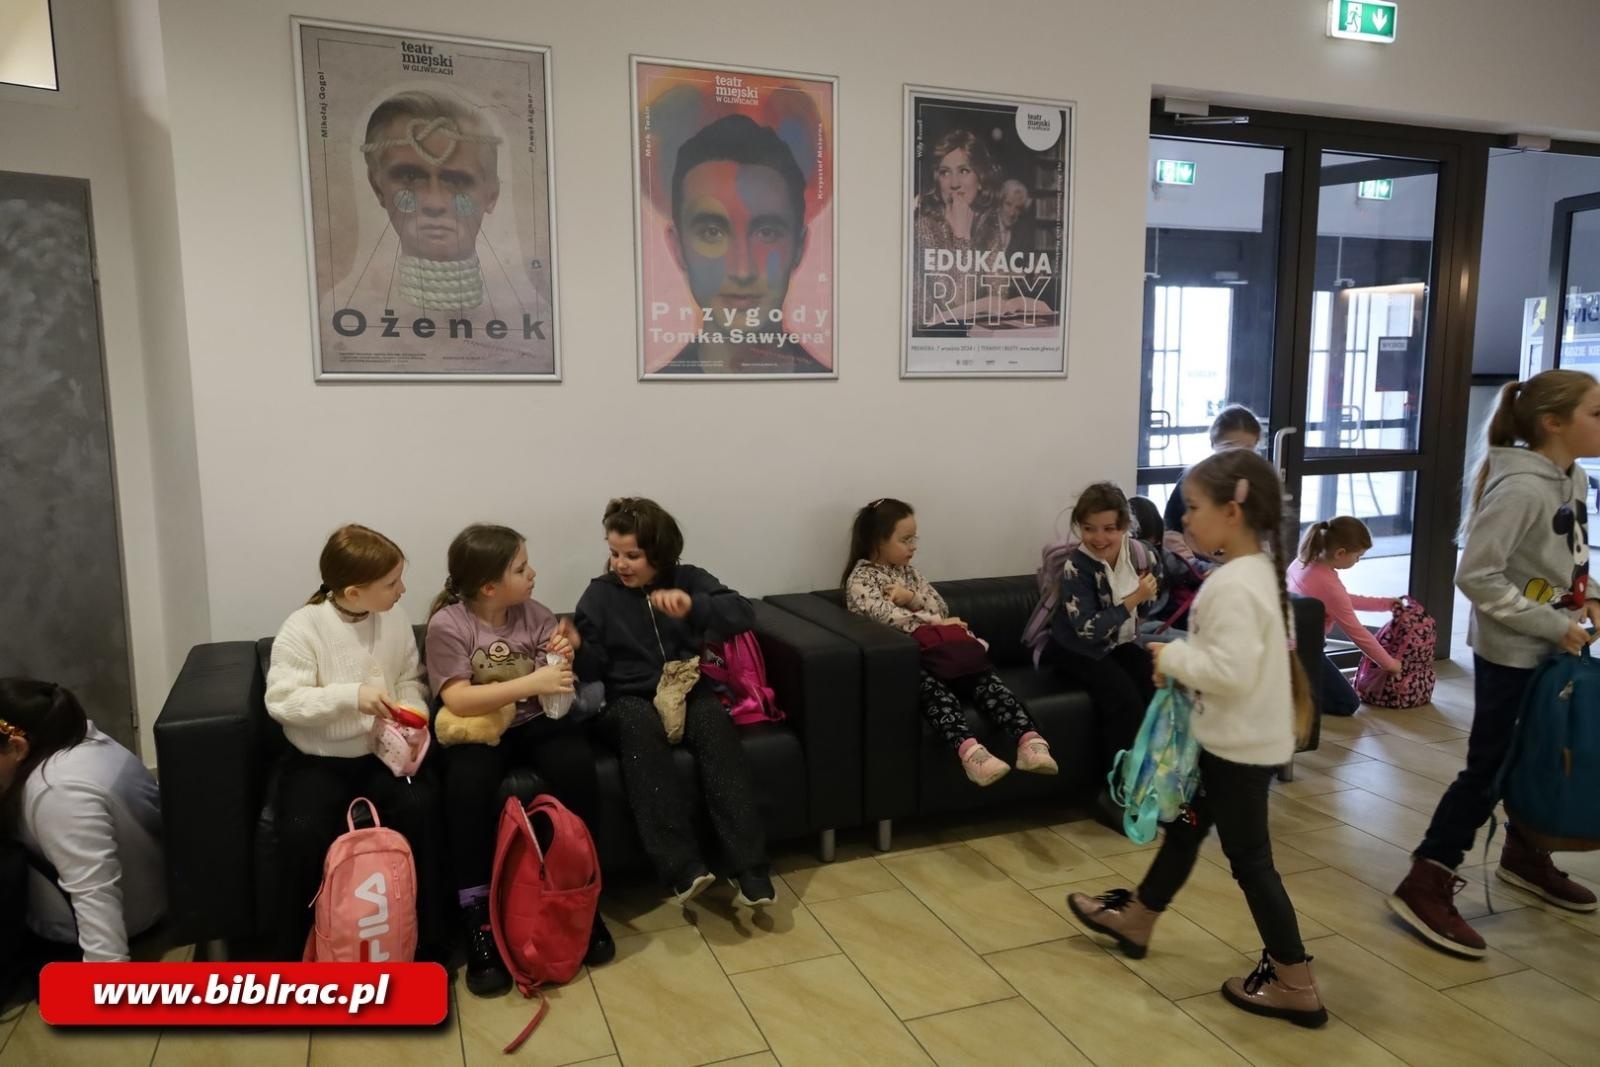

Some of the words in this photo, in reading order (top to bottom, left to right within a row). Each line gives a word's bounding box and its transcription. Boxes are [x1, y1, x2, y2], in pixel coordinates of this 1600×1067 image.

[401, 41, 434, 55] teatr
[402, 53, 453, 68] miejski
[411, 65, 454, 76] GLIWICACH
[318, 71, 327, 100] Gogol
[715, 75, 742, 87] teatr
[716, 86, 759, 99] miejski
[320, 103, 328, 138] Mikołaj
[1027, 113, 1042, 121] teatr
[924, 248, 1052, 274] EDUKACJA
[923, 273, 1052, 326] RITY
[651, 302, 829, 327] Przygody
[332, 308, 546, 340] Ożenek
[649, 328, 725, 344] Tomka
